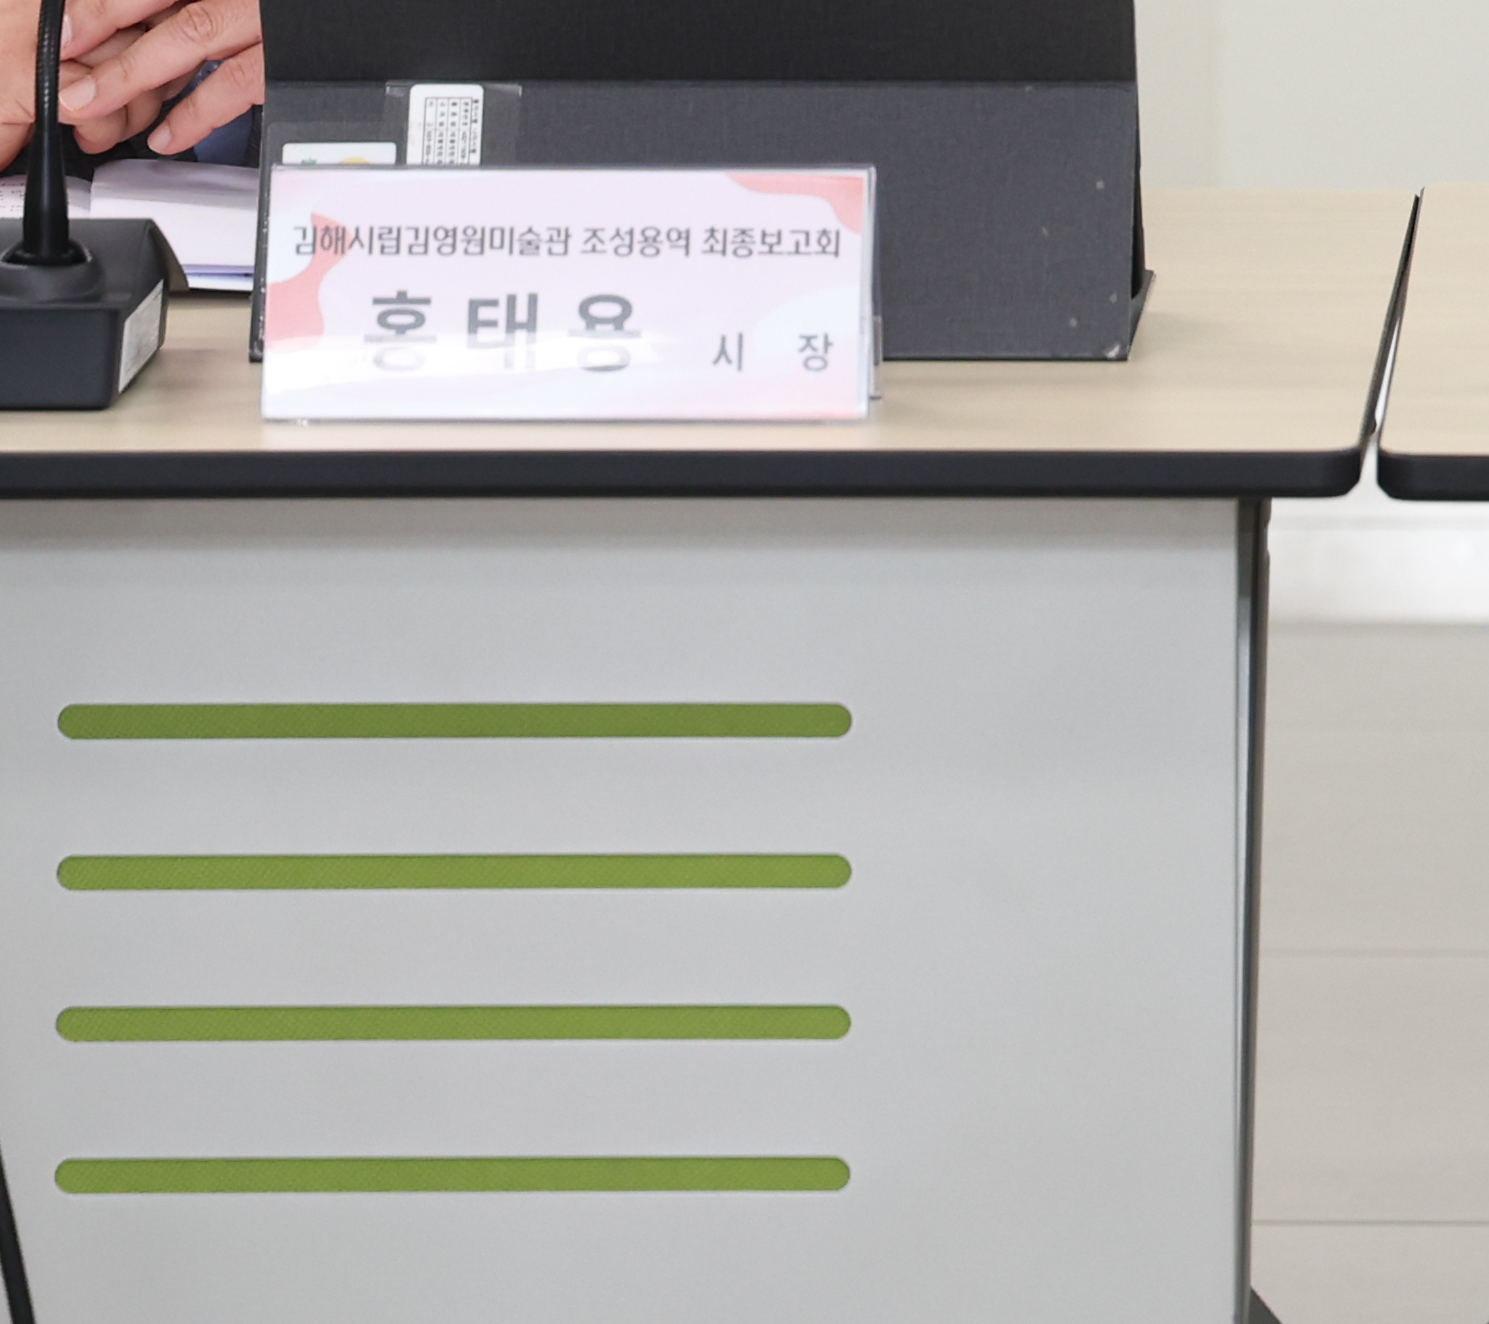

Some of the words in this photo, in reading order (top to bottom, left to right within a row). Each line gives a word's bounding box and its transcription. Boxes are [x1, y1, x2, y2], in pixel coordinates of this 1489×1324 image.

[293, 224, 572, 257] 김해시립김영원미술관
[580, 226, 692, 258] 조성용역
[701, 226, 842, 259] 최종보고회
